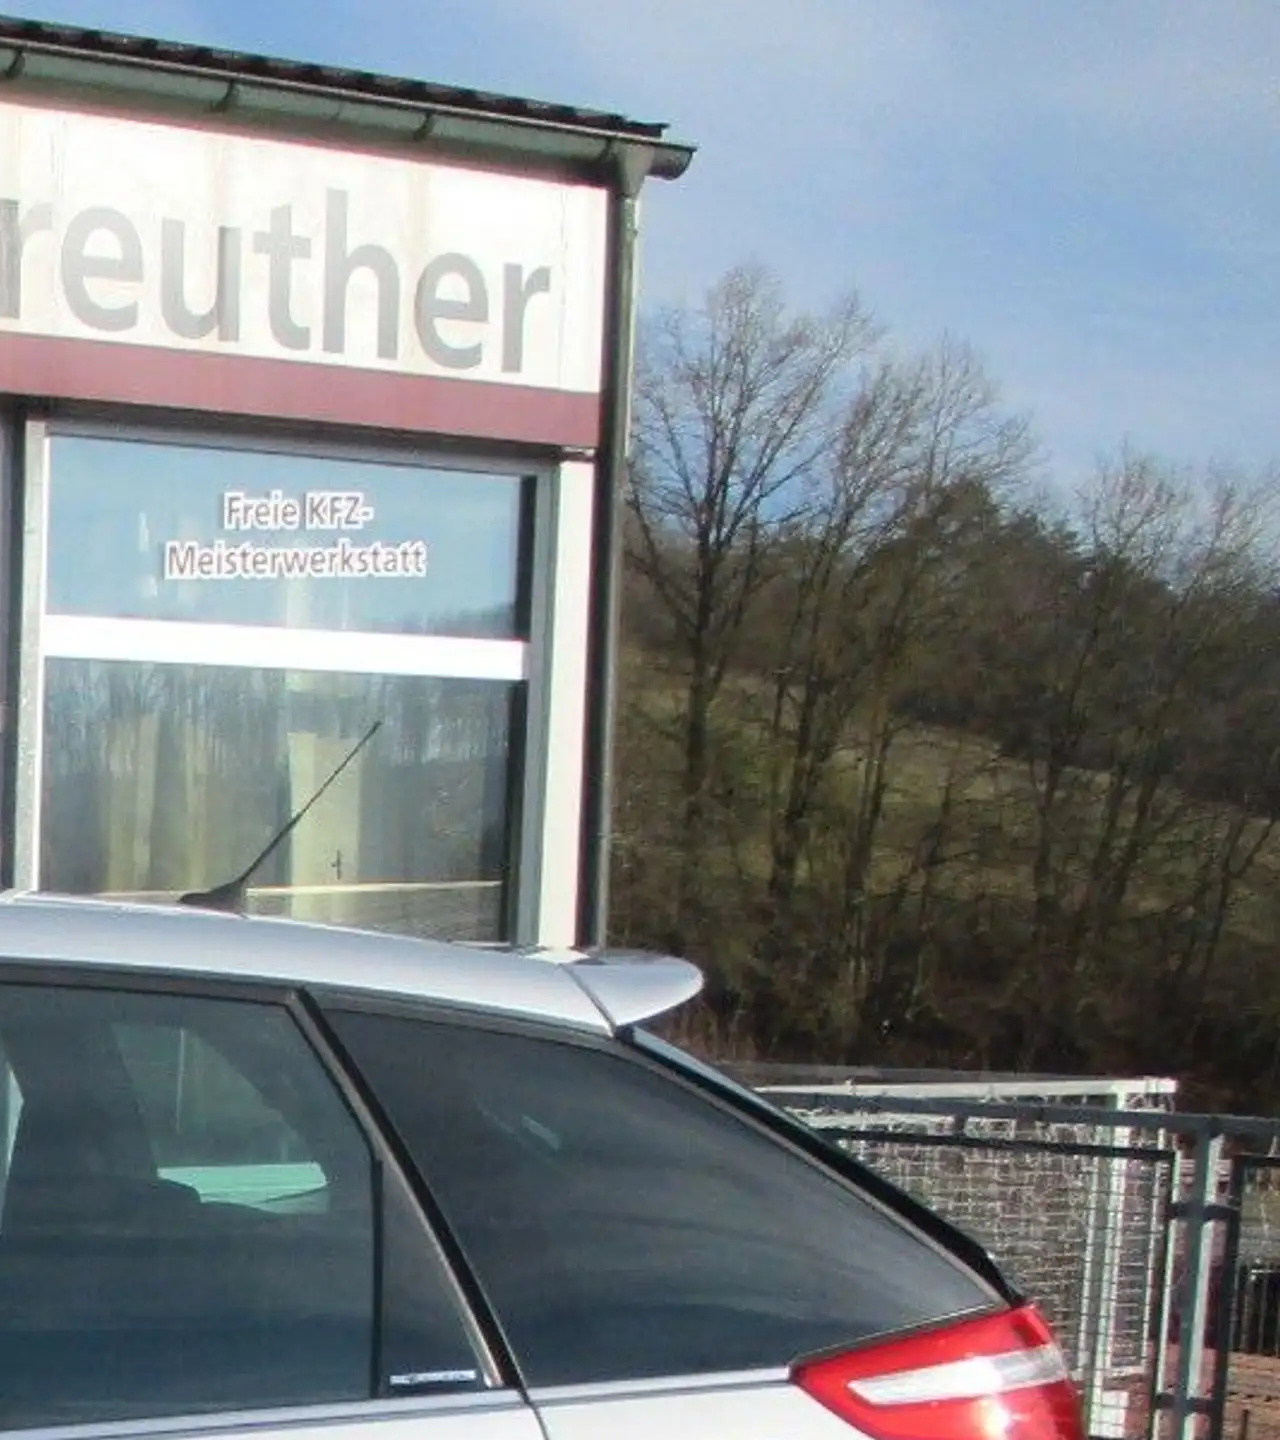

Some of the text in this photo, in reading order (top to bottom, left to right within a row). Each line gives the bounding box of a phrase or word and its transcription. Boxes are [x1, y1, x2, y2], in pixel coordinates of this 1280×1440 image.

[224, 490, 375, 531] Freie KFZ-
[163, 538, 429, 580] Meisterwerkstatt
